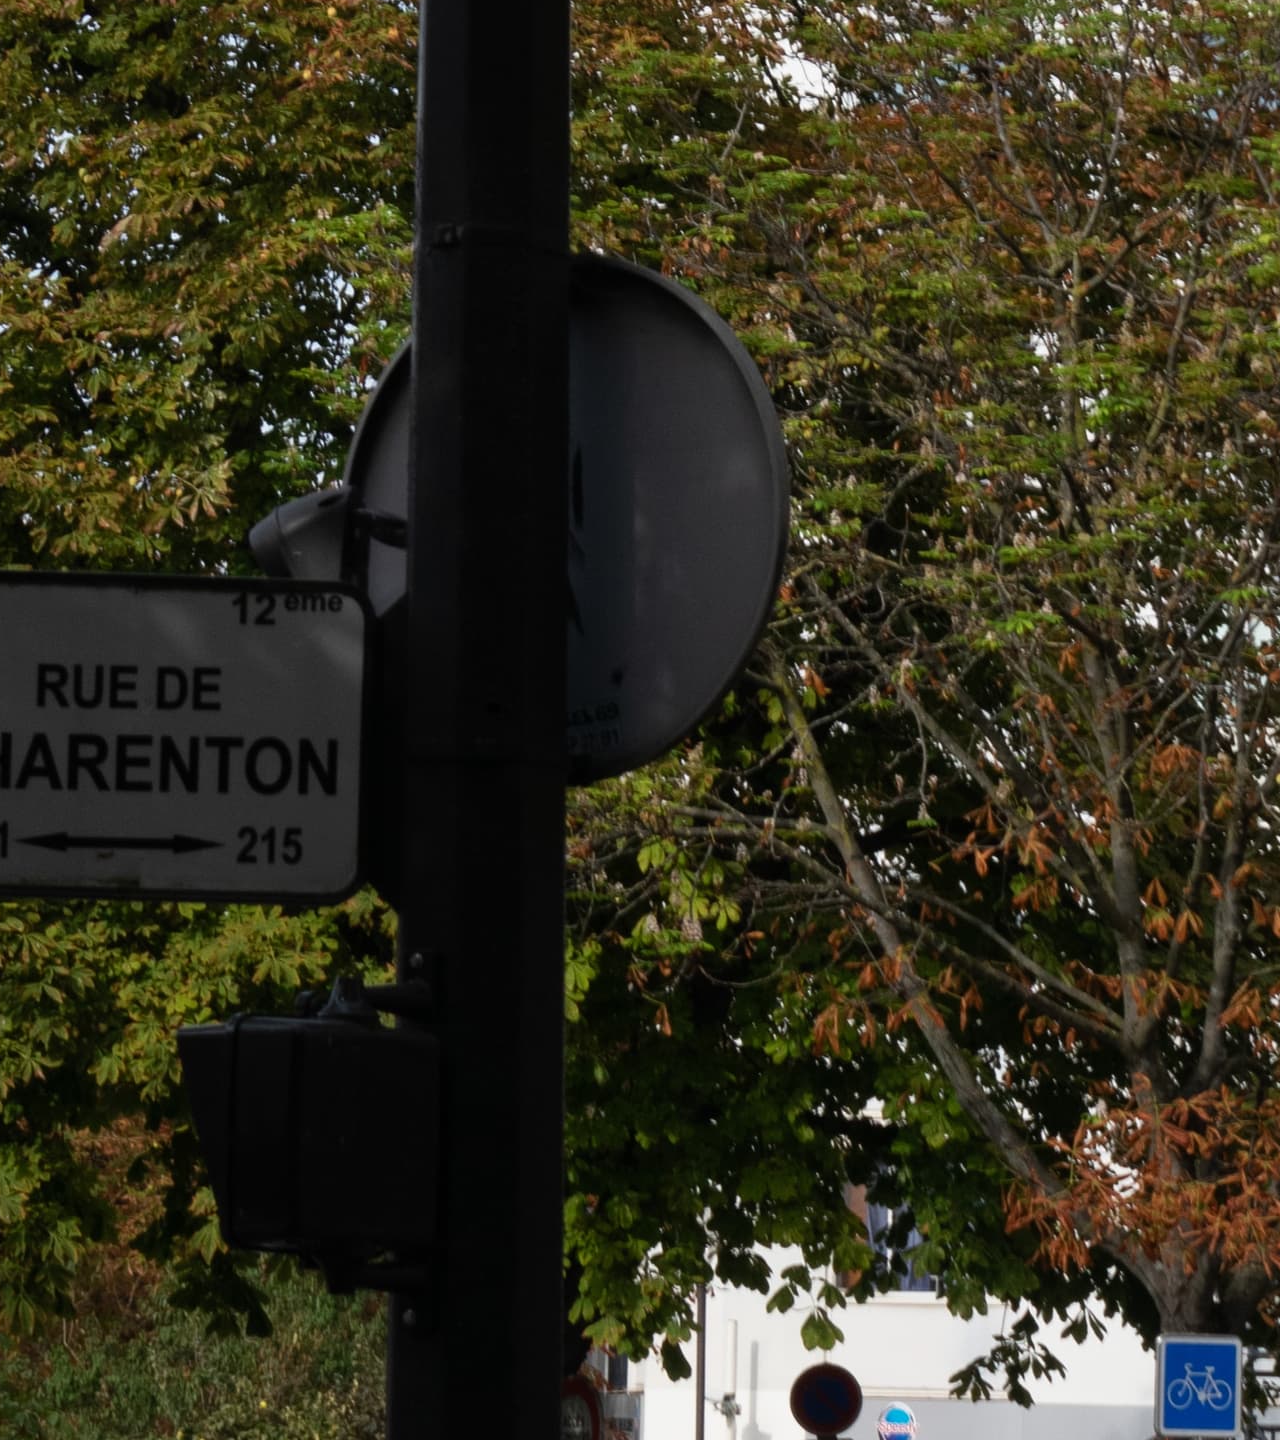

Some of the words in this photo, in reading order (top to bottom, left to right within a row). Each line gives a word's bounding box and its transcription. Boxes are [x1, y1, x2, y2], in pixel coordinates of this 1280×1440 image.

[232, 592, 276, 625] 12
[35, 663, 138, 710] RUE
[155, 667, 222, 712] DE
[236, 826, 303, 865] 215
